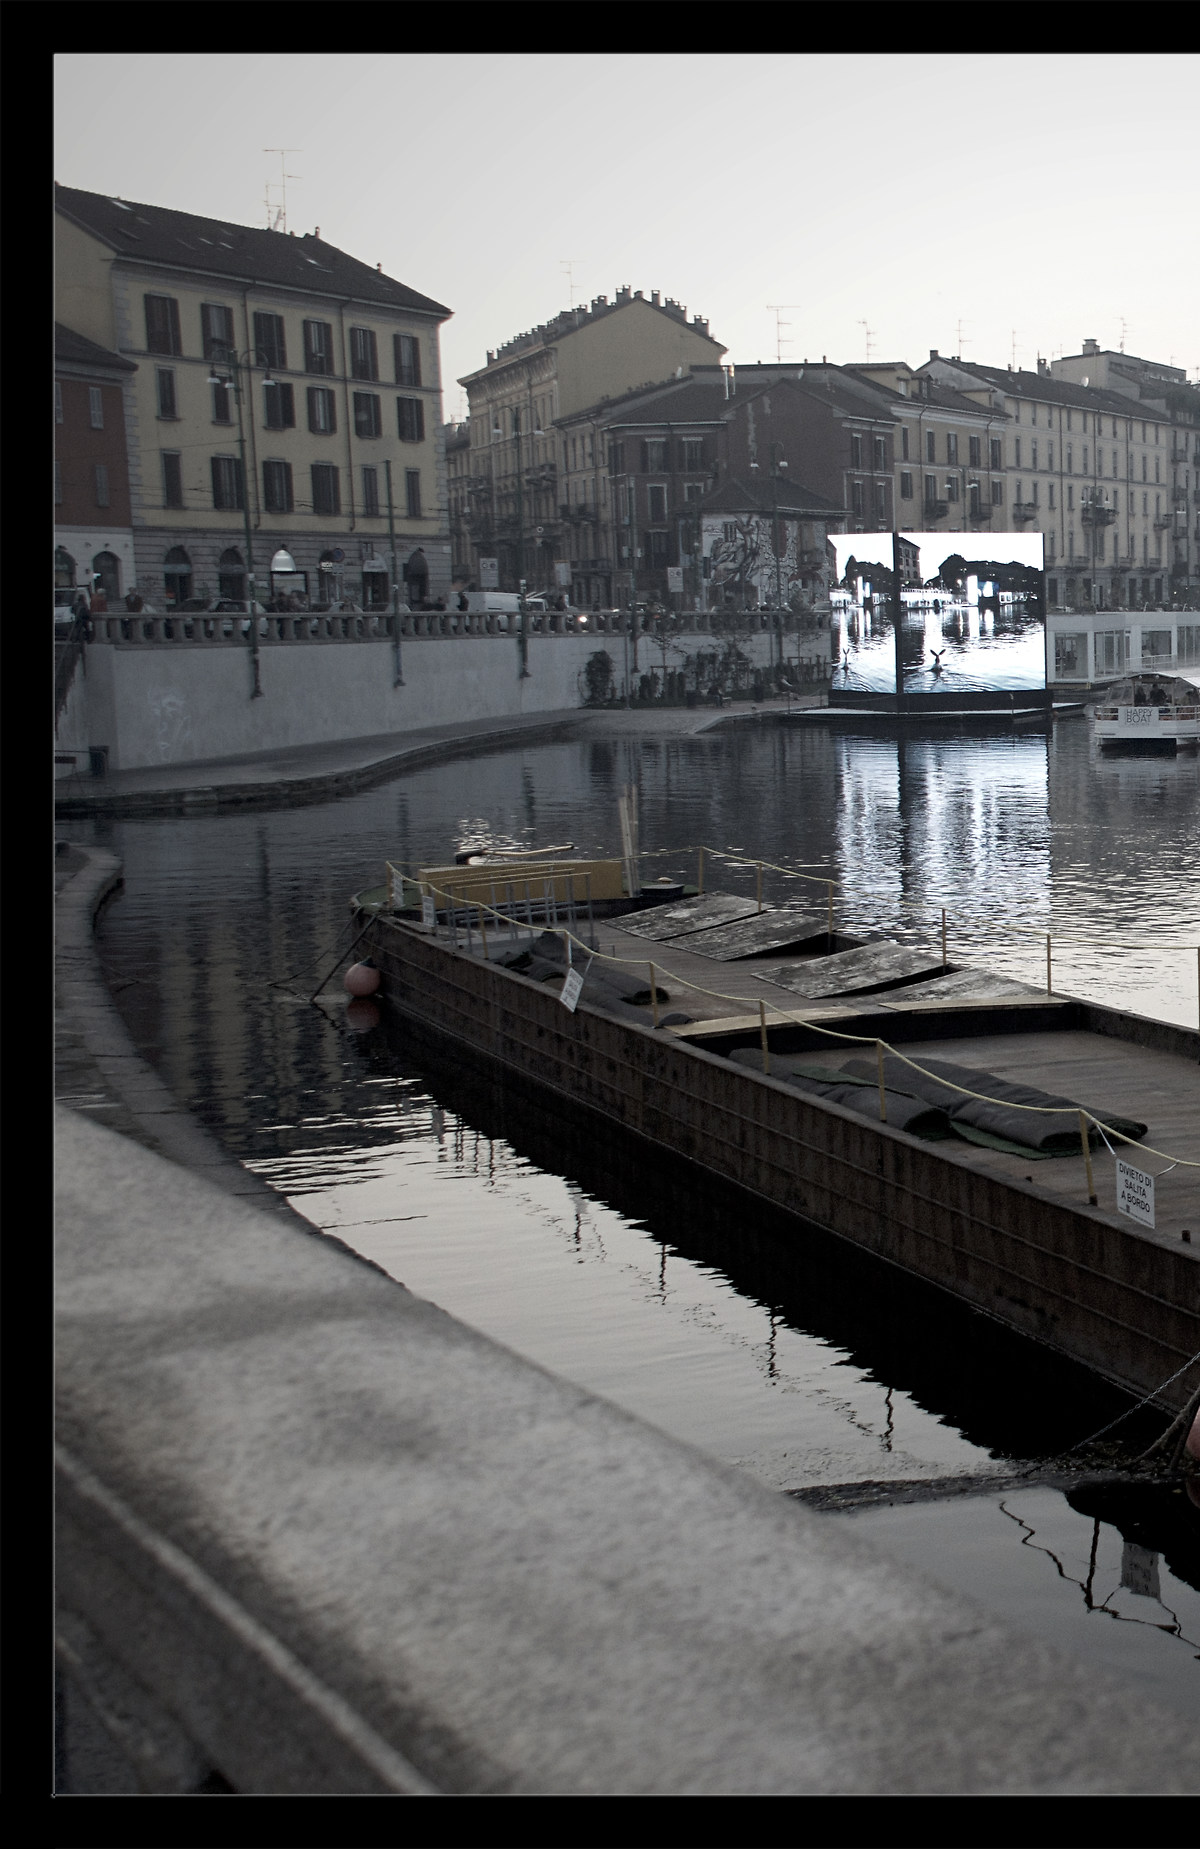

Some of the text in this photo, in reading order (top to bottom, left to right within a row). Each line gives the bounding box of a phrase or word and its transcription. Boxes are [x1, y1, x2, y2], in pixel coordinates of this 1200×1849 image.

[1126, 708, 1153, 716] HAPPY
[1126, 714, 1151, 723] BOAT
[1119, 1163, 1152, 1188] DIVIETO DI
[1124, 1179, 1147, 1198] SALITA
[1121, 1190, 1151, 1213] A BORDO
